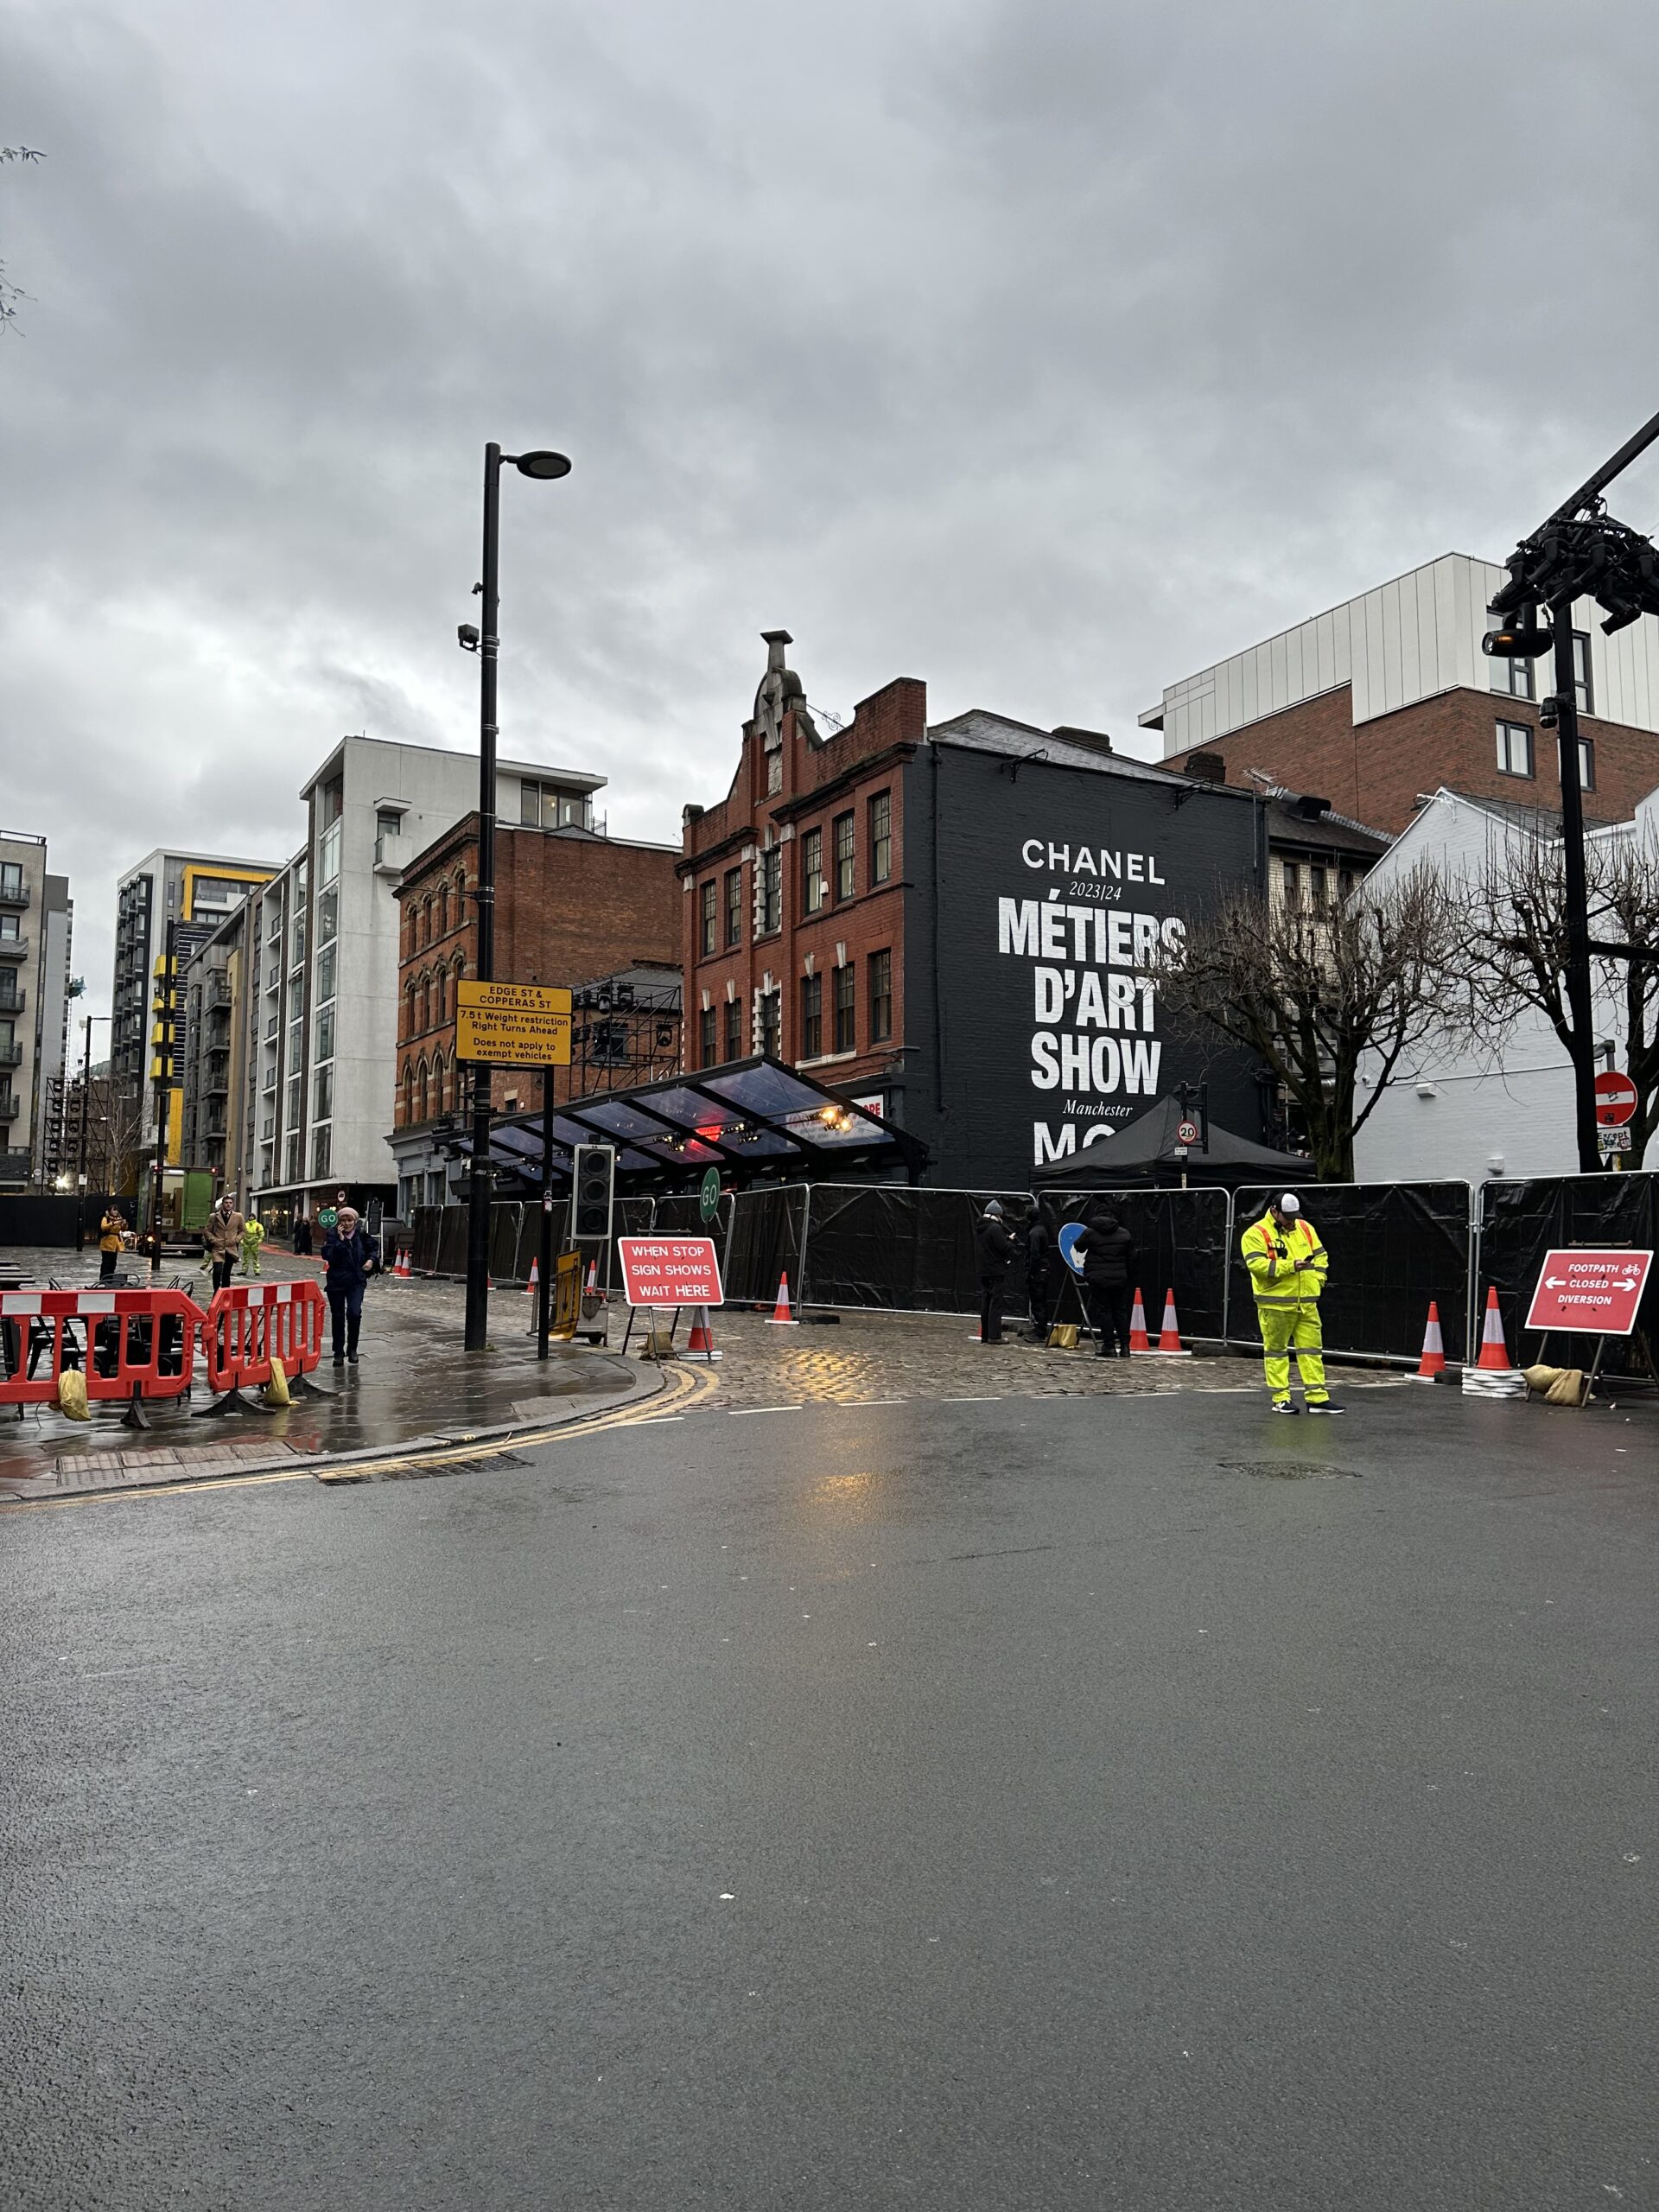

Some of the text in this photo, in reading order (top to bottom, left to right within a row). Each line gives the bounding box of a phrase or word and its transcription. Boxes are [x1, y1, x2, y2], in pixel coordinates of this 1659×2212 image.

[1022, 839, 1165, 885] CHANEL
[999, 888, 1186, 971] MÉTIERS
[490, 987, 517, 995] EDGE
[480, 995, 535, 1007] COPPERAS
[1035, 966, 1160, 1032] D'ART
[486, 1012, 518, 1022] Weight
[521, 1016, 568, 1026] restriction
[473, 1021, 557, 1034] Right Turns Ahead
[474, 1038, 555, 1051] Does not apply to
[477, 1049, 551, 1060] exempt vehicles
[1031, 1031, 1161, 1095] SHOW
[1063, 1099, 1133, 1117] Manchester
[1180, 1128, 1194, 1137] 20
[702, 1185, 716, 1206] GO
[632, 1246, 704, 1256] WHEN STOP
[632, 1265, 711, 1275] SIGN SHOWS
[1568, 1264, 1619, 1273] FOOTPATH
[1569, 1280, 1609, 1288] CLOSED
[639, 1285, 710, 1297] WAIT HERE
[1558, 1294, 1612, 1305] DIVERSION
